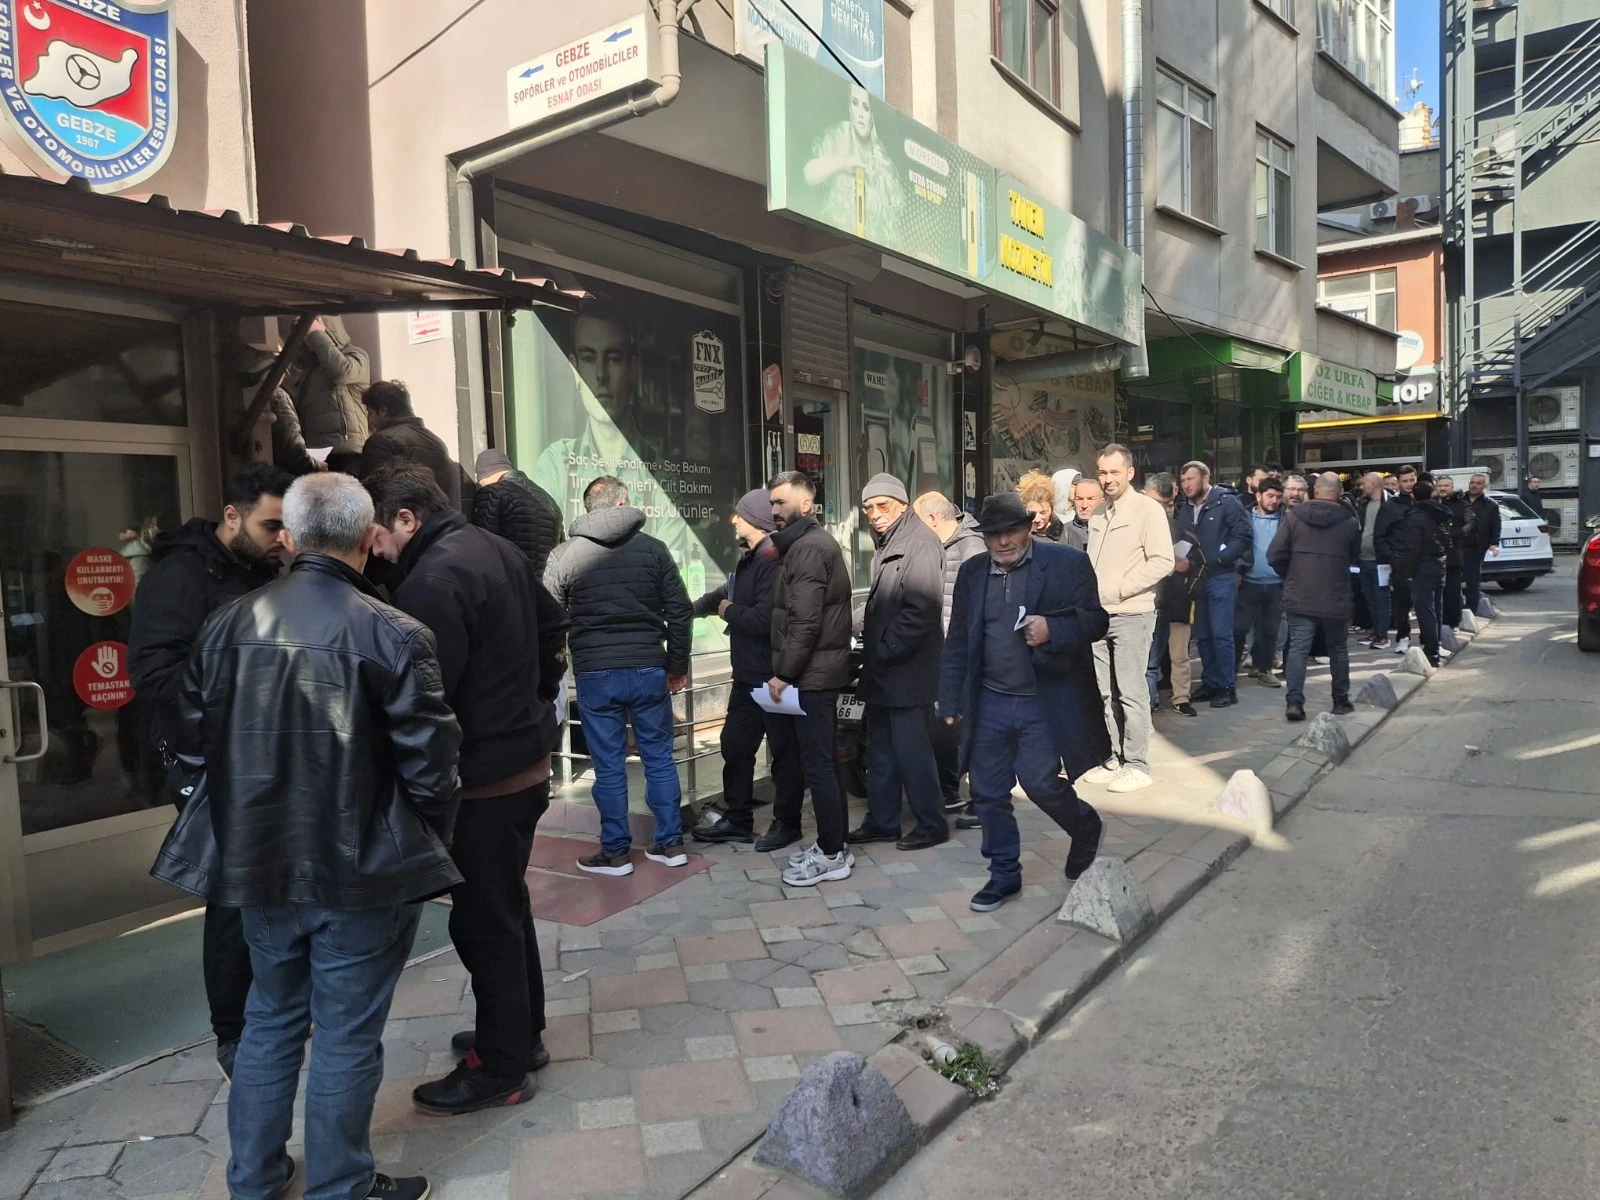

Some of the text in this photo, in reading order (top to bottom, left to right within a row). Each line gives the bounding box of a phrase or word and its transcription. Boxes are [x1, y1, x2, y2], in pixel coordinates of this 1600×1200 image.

[66, 0, 121, 22] BZE
[155, 37, 167, 93] ODASI
[555, 41, 591, 68] GEBZE
[556, 76, 567, 87] ve
[568, 45, 639, 82] OTOMOBİLCİLER
[6, 86, 27, 112] VE
[547, 78, 602, 108] ESNAF ODASI
[56, 112, 117, 143] GEBZE
[149, 97, 167, 150] ESNAF
[23, 116, 155, 179] OTOMOBİLCİLER
[695, 341, 721, 364] FNX
[866, 373, 887, 387] WAHL
[1334, 369, 1365, 389] URFA
[1337, 389, 1343, 404] &
[1345, 391, 1371, 410] KEBAP
[568, 452, 589, 469] Saç
[664, 460, 681, 475] Saç
[682, 461, 711, 475] Bakımı
[660, 479, 678, 493] Cilt
[680, 480, 712, 494] Bakımı
[667, 499, 714, 519] Ürünler
[86, 555, 112, 563] MASKE
[88, 680, 130, 691] TEMASTAN
[91, 691, 128, 703] KAÇININ!
